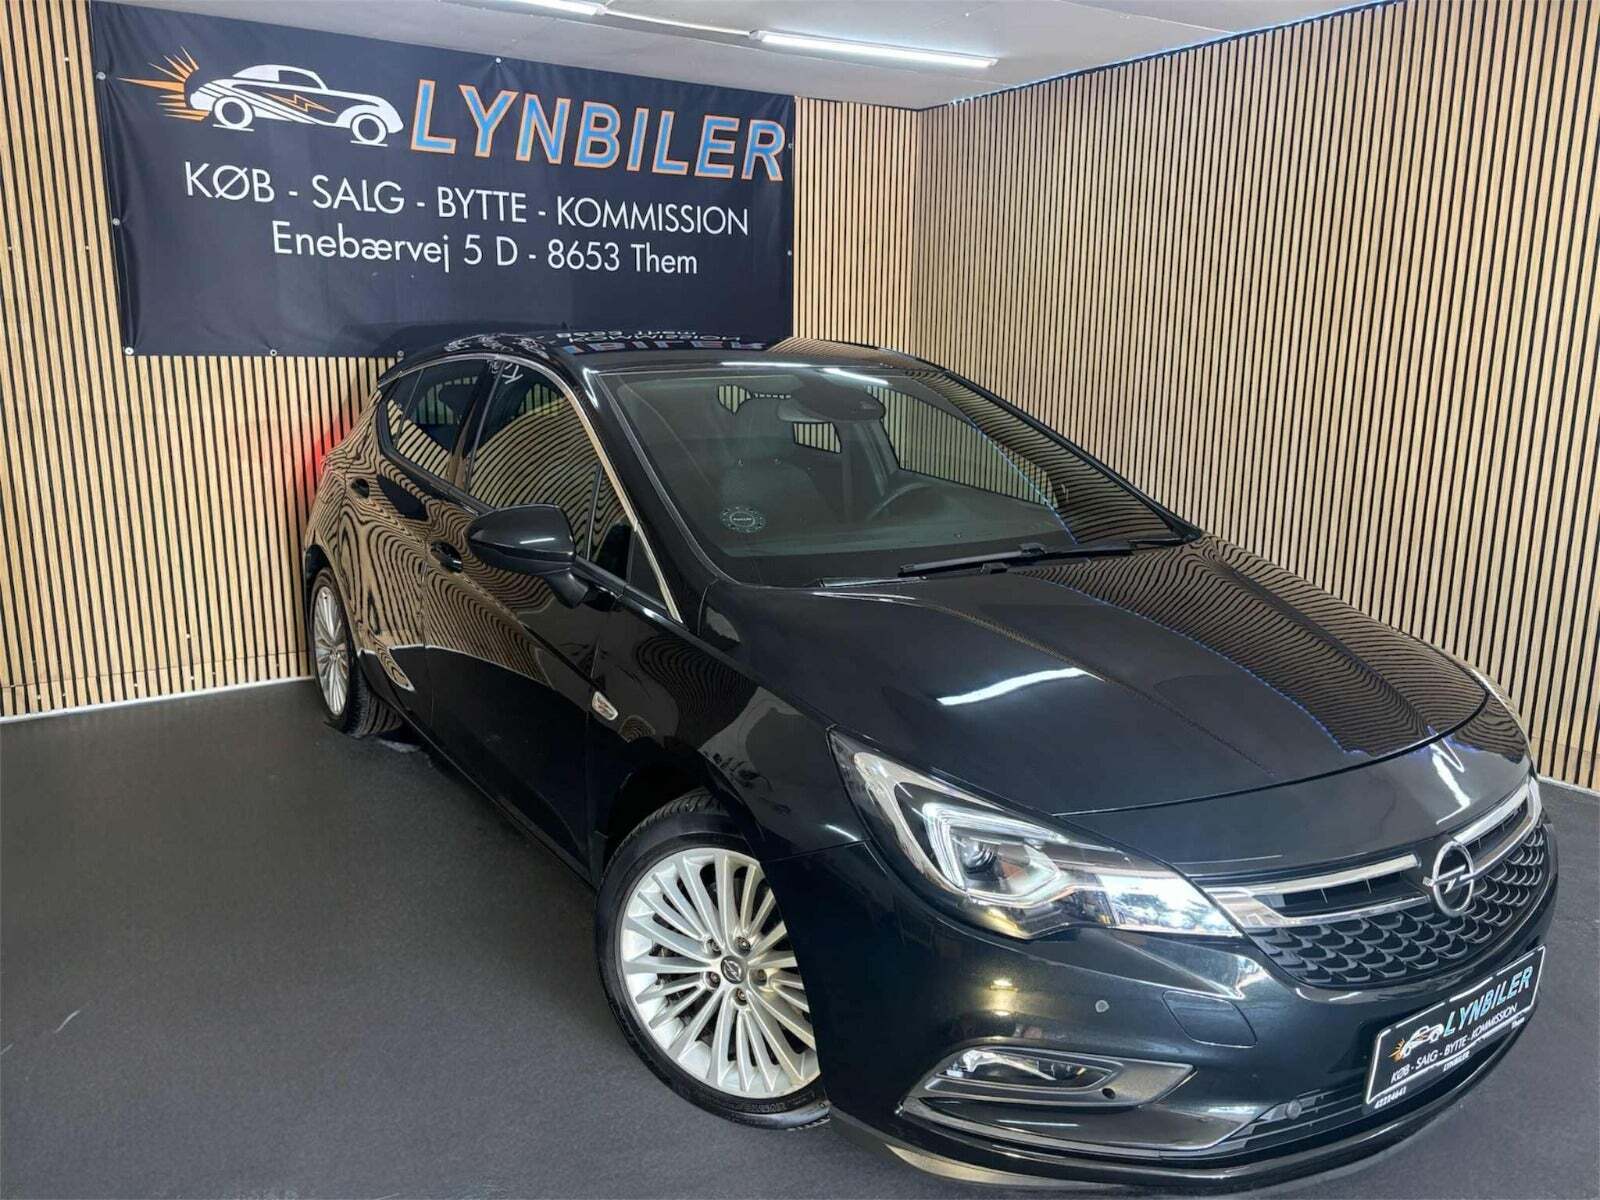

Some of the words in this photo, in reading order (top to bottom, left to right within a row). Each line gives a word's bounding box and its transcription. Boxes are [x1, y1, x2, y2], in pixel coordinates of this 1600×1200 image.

[410, 79, 785, 181] LYNBILER
[184, 161, 276, 203] KØB
[311, 174, 405, 215] SALG
[437, 185, 527, 223] BYTTE
[556, 195, 749, 236] KOMMISSION
[271, 219, 450, 274] Enebærvej
[463, 233, 483, 265] 5
[495, 235, 518, 266] D
[547, 238, 620, 272] 8653
[630, 241, 697, 275] Them
[1443, 966, 1533, 1037] LYNBILER
[1444, 1034, 1468, 1056] BYTTE
